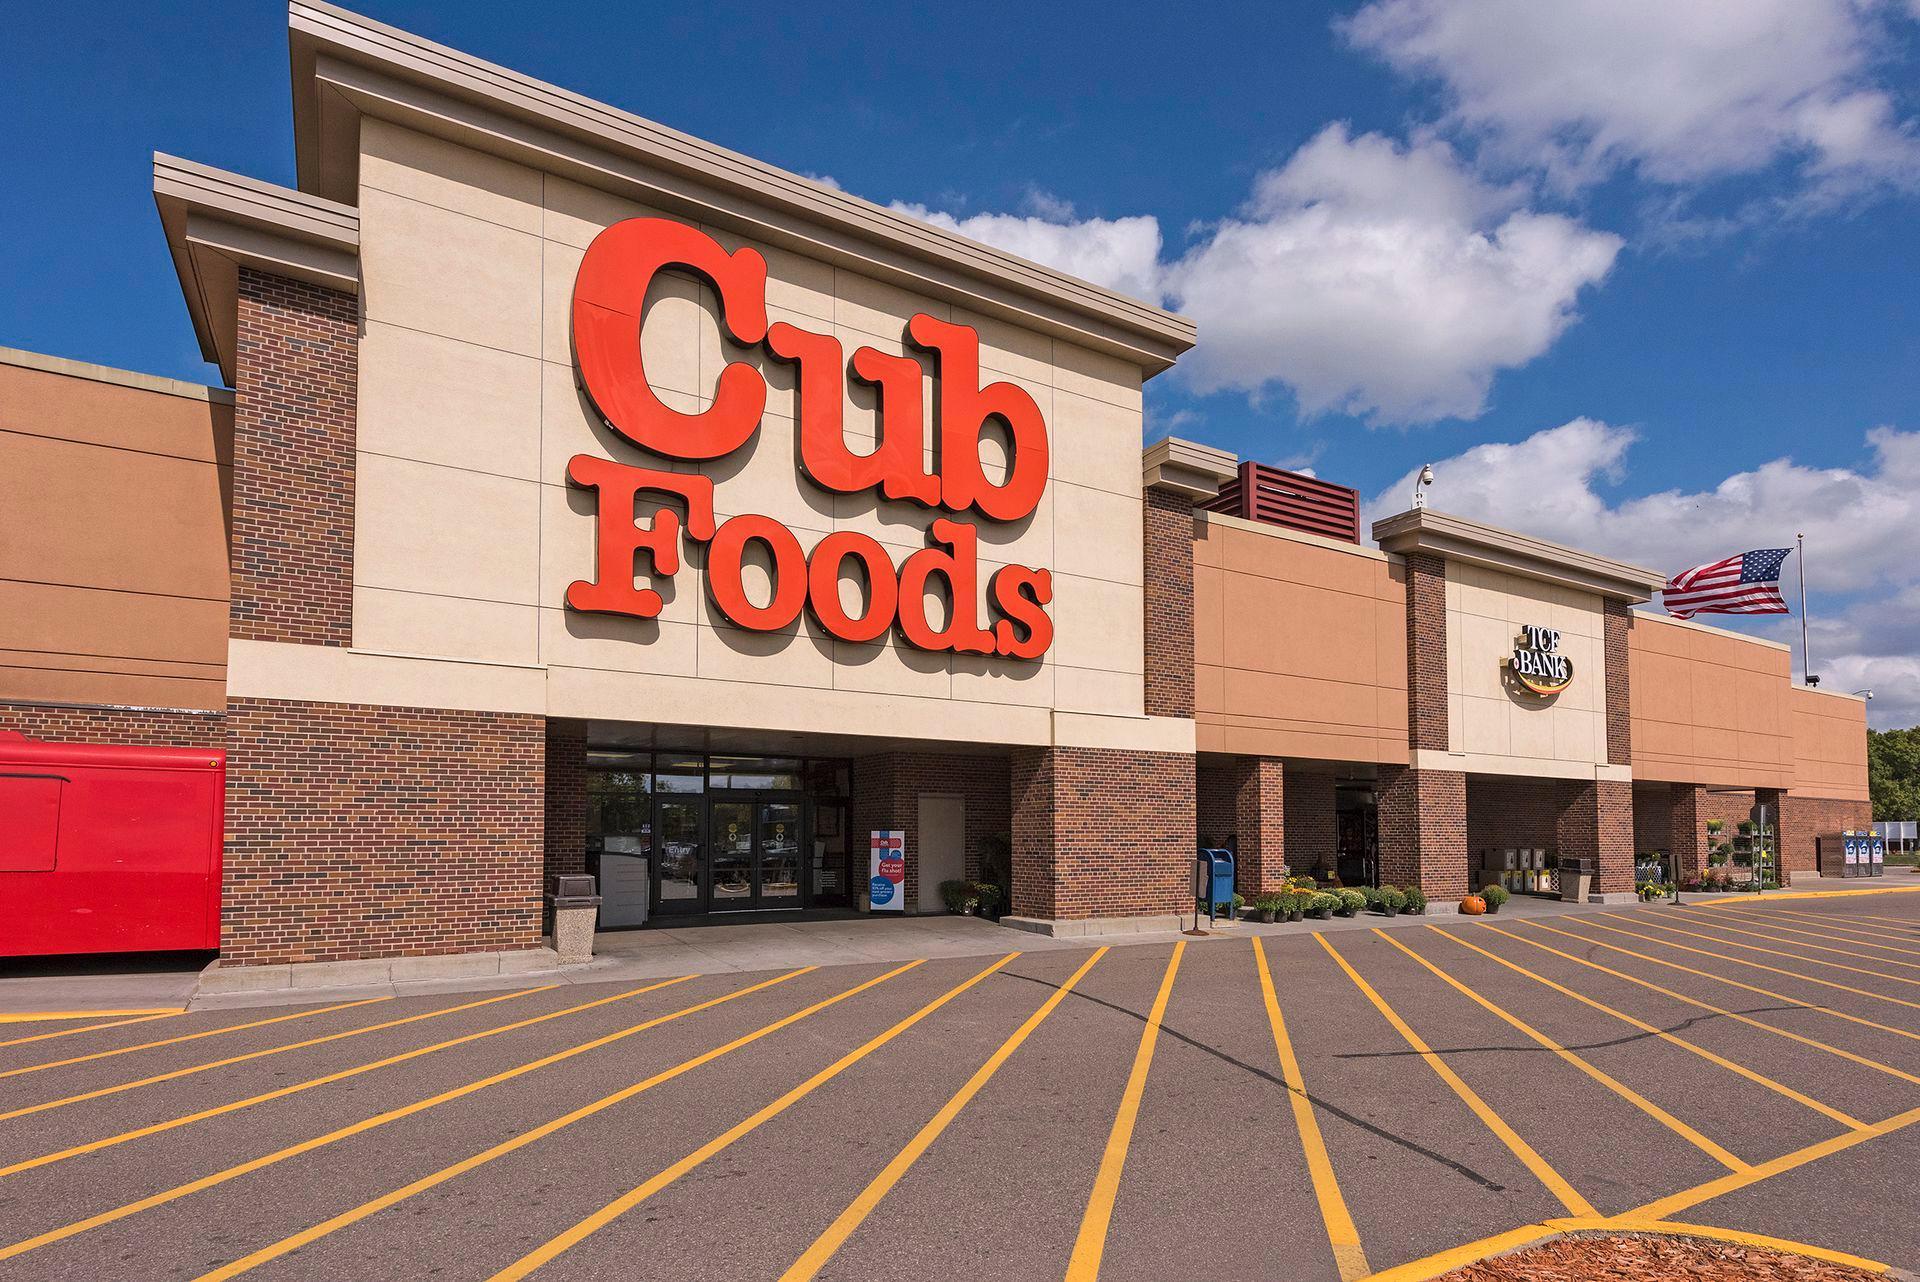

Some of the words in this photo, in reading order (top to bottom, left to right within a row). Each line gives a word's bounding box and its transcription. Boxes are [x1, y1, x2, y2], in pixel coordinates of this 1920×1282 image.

[570, 217, 1049, 521] Cub
[566, 454, 1054, 660] Foods
[1527, 625, 1560, 652] TCF
[1518, 649, 1568, 679] BANK
[668, 845, 691, 855] Entry
